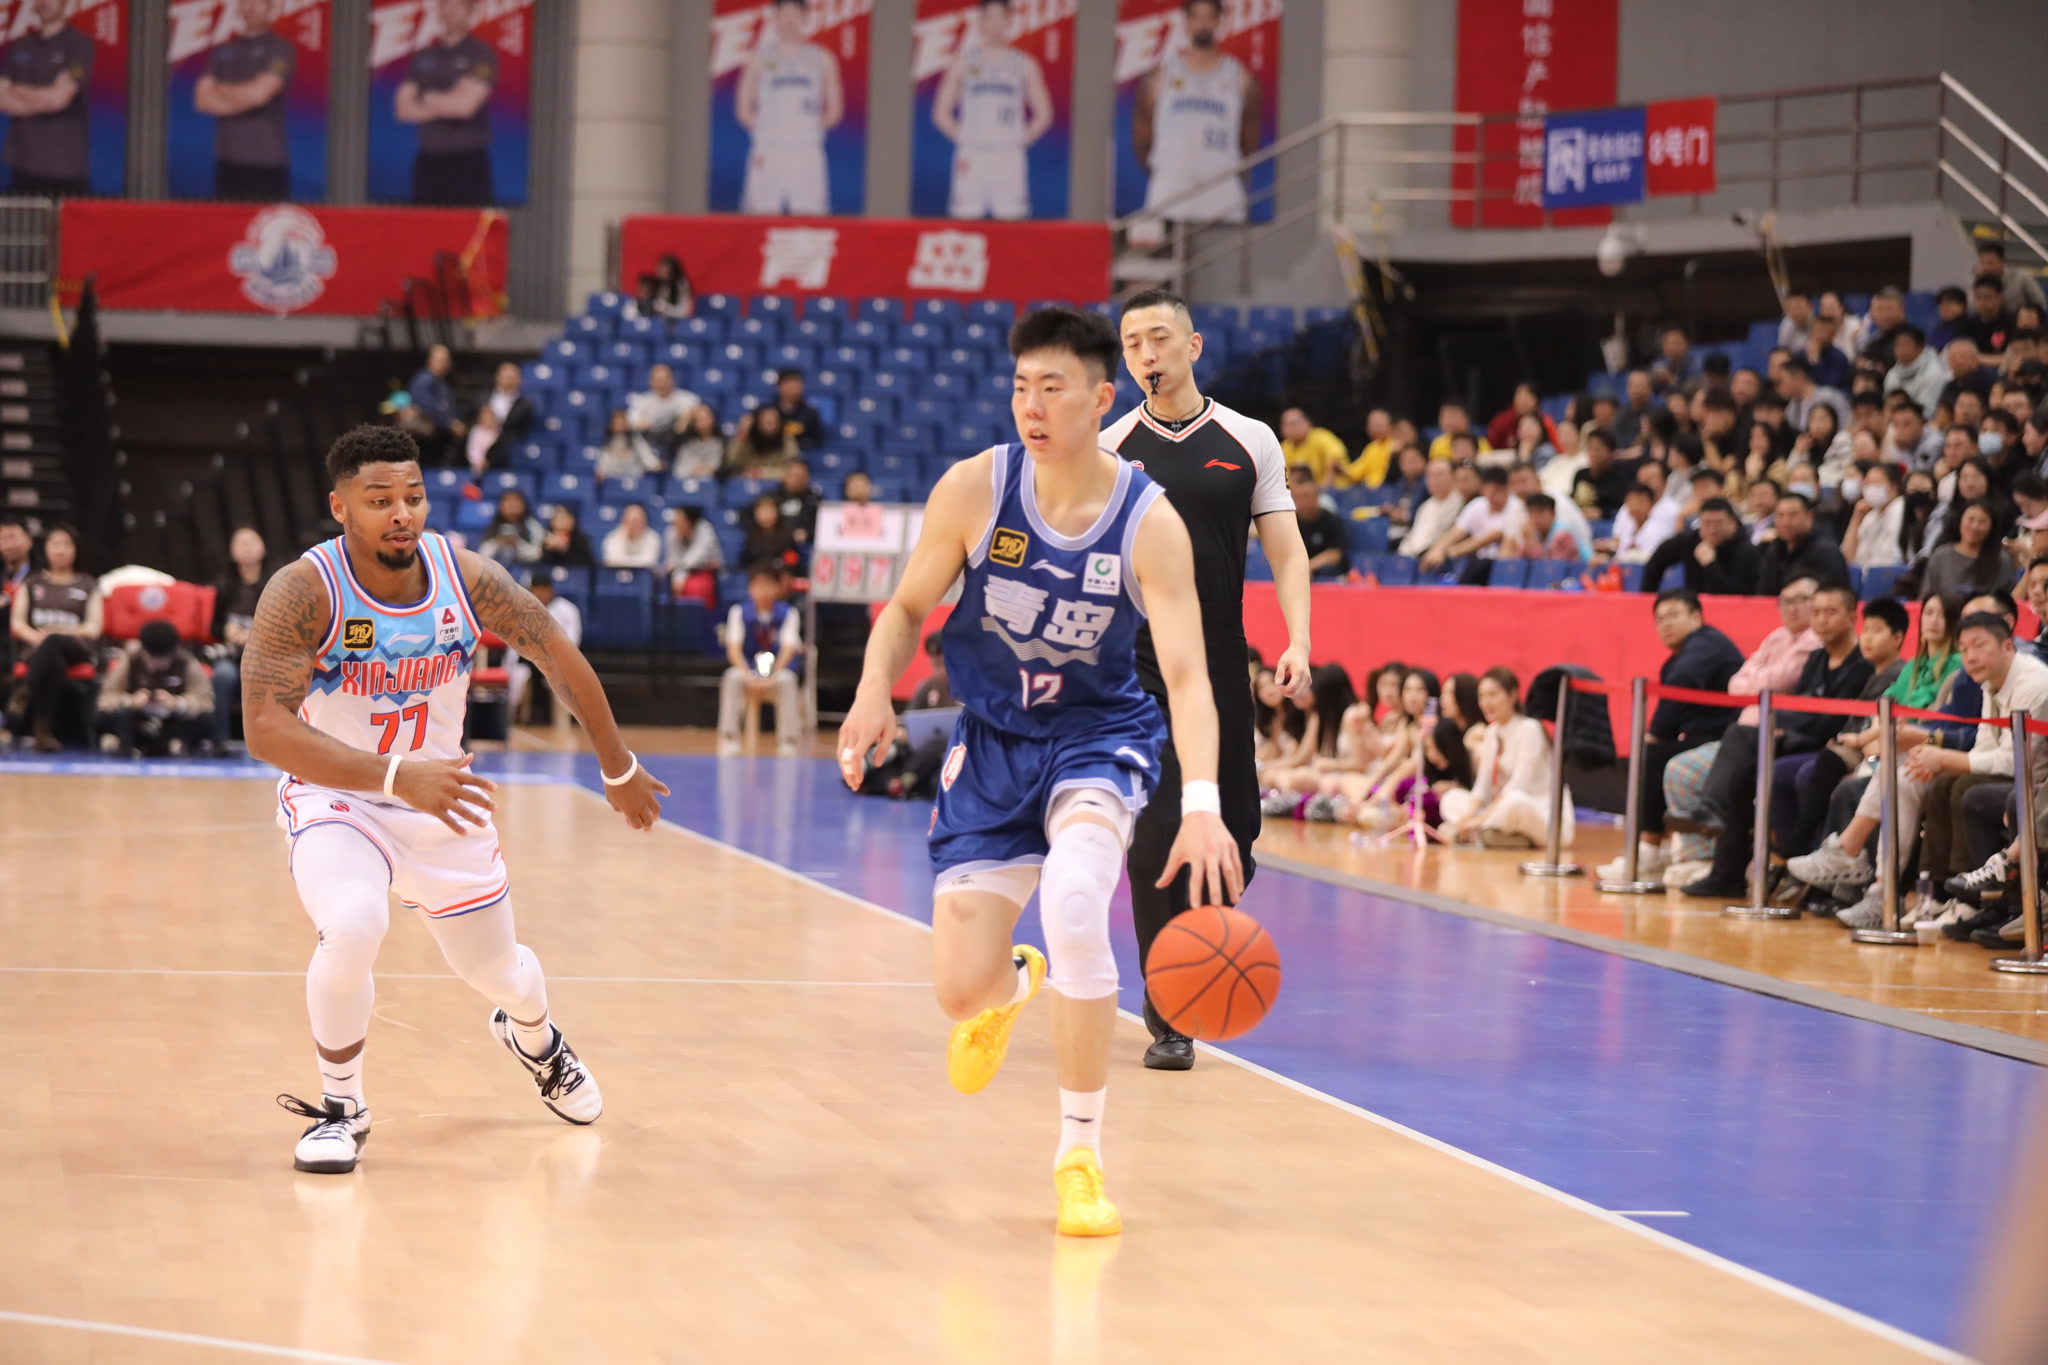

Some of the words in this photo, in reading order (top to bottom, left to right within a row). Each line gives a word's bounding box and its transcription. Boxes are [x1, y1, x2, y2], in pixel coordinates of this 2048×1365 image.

[759, 226, 991, 292] 青岛
[983, 574, 1115, 649] 青岛
[443, 634, 456, 642] CGB
[341, 650, 462, 697] XINJIANG
[1018, 667, 1063, 711] 12
[370, 702, 429, 756] 77
